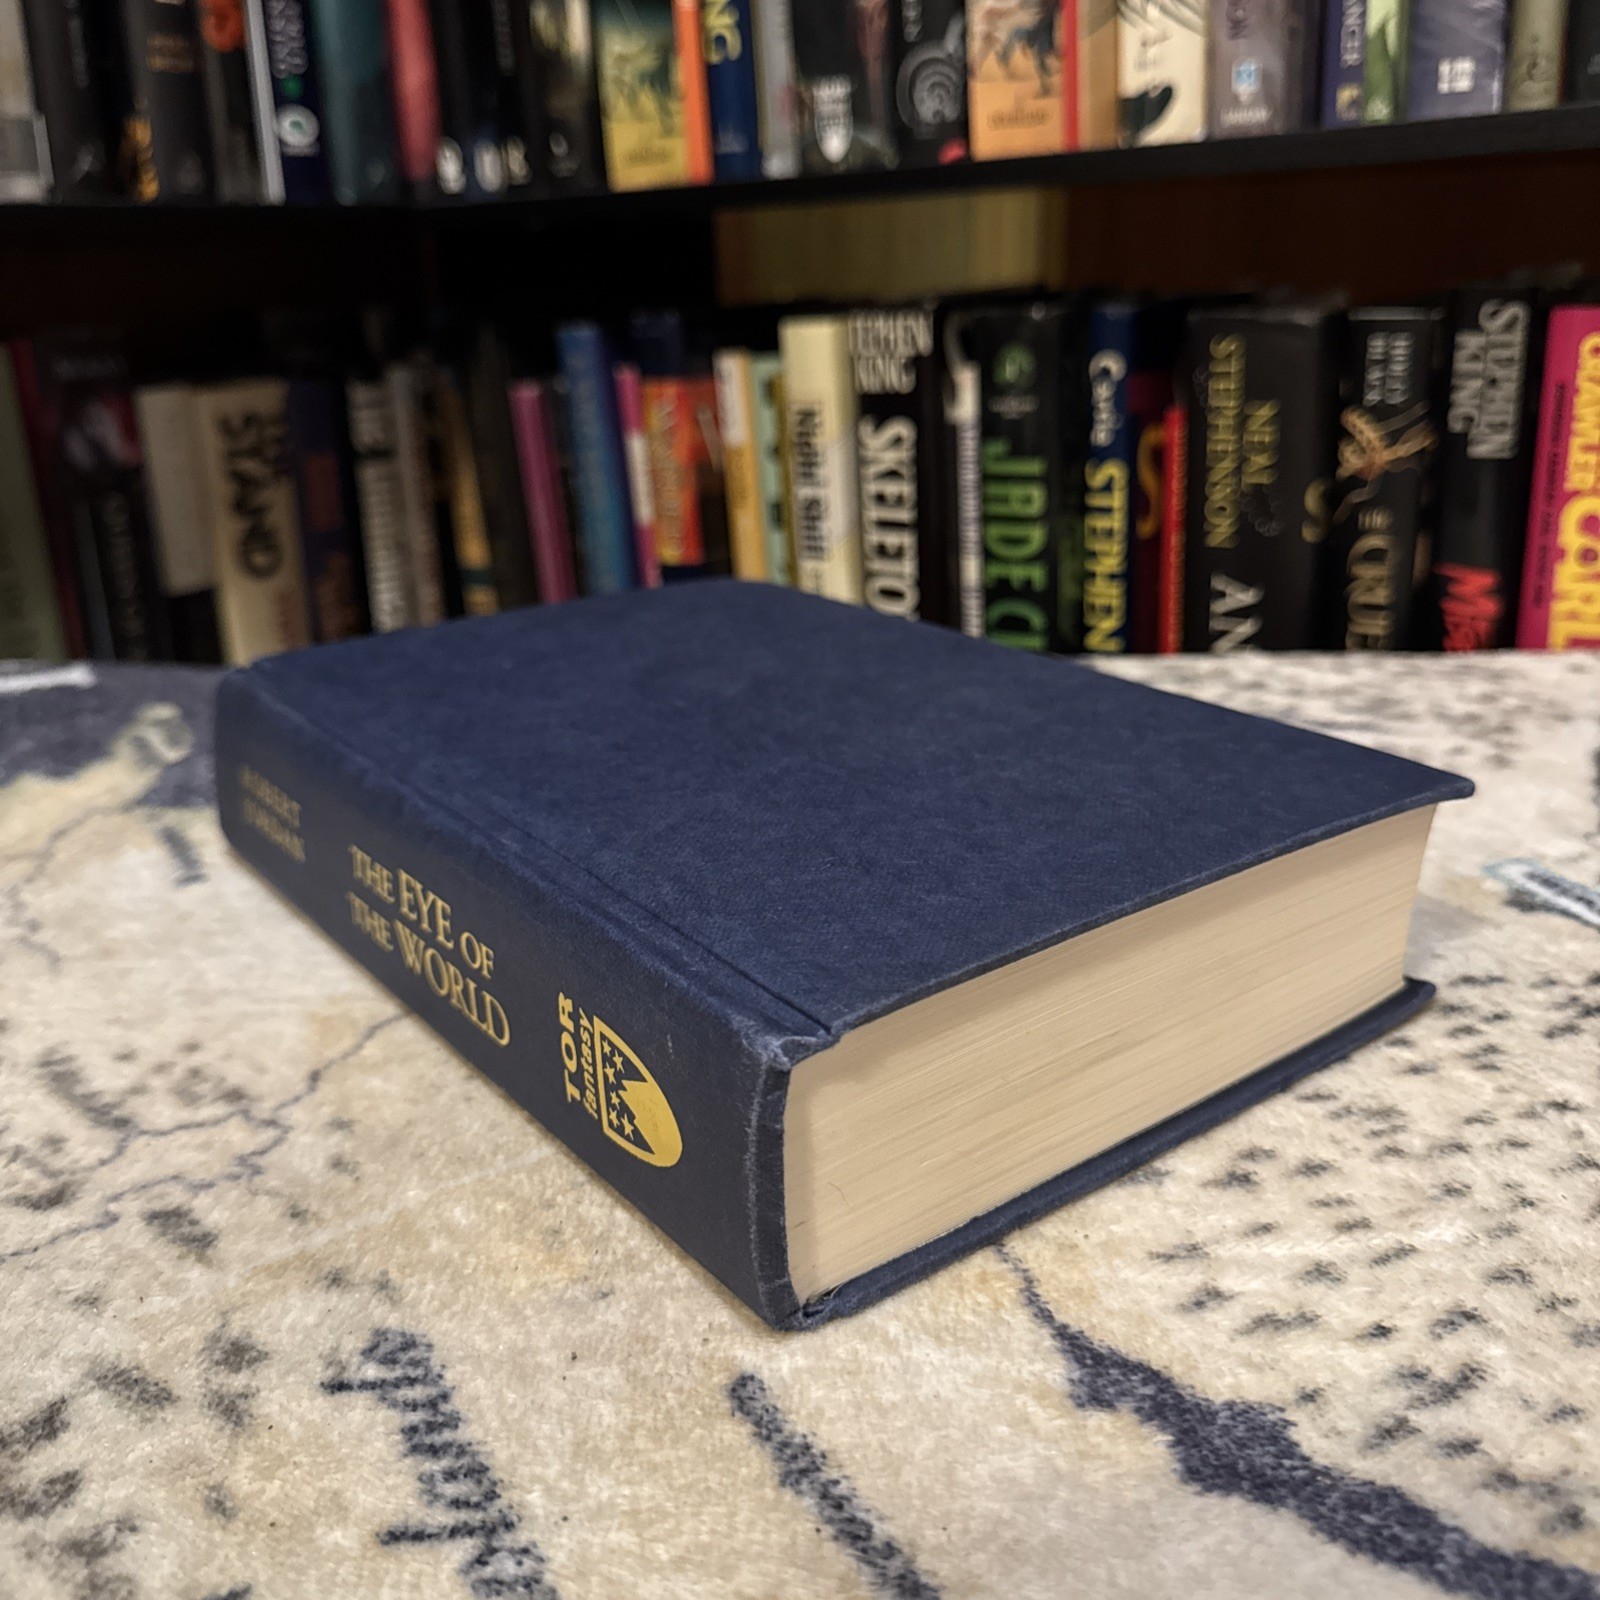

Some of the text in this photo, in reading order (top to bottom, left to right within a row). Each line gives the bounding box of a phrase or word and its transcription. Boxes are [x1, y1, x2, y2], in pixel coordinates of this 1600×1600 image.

[1204, 333, 1246, 548] STEPHENSON
[1242, 400, 1280, 491] NEAL
[1447, 329, 1487, 434] KING
[1467, 300, 1530, 459] STEPHEN
[857, 414, 919, 621] SKELETO
[982, 438, 1049, 592] JADE
[1084, 458, 1129, 652] STEPHEN
[1546, 493, 1600, 651] CARL
[347, 891, 510, 1046] THE WORLD
[349, 845, 494, 980] THE EYE OF
[558, 991, 581, 1103] TOR
[579, 1006, 599, 1120] fantasy
